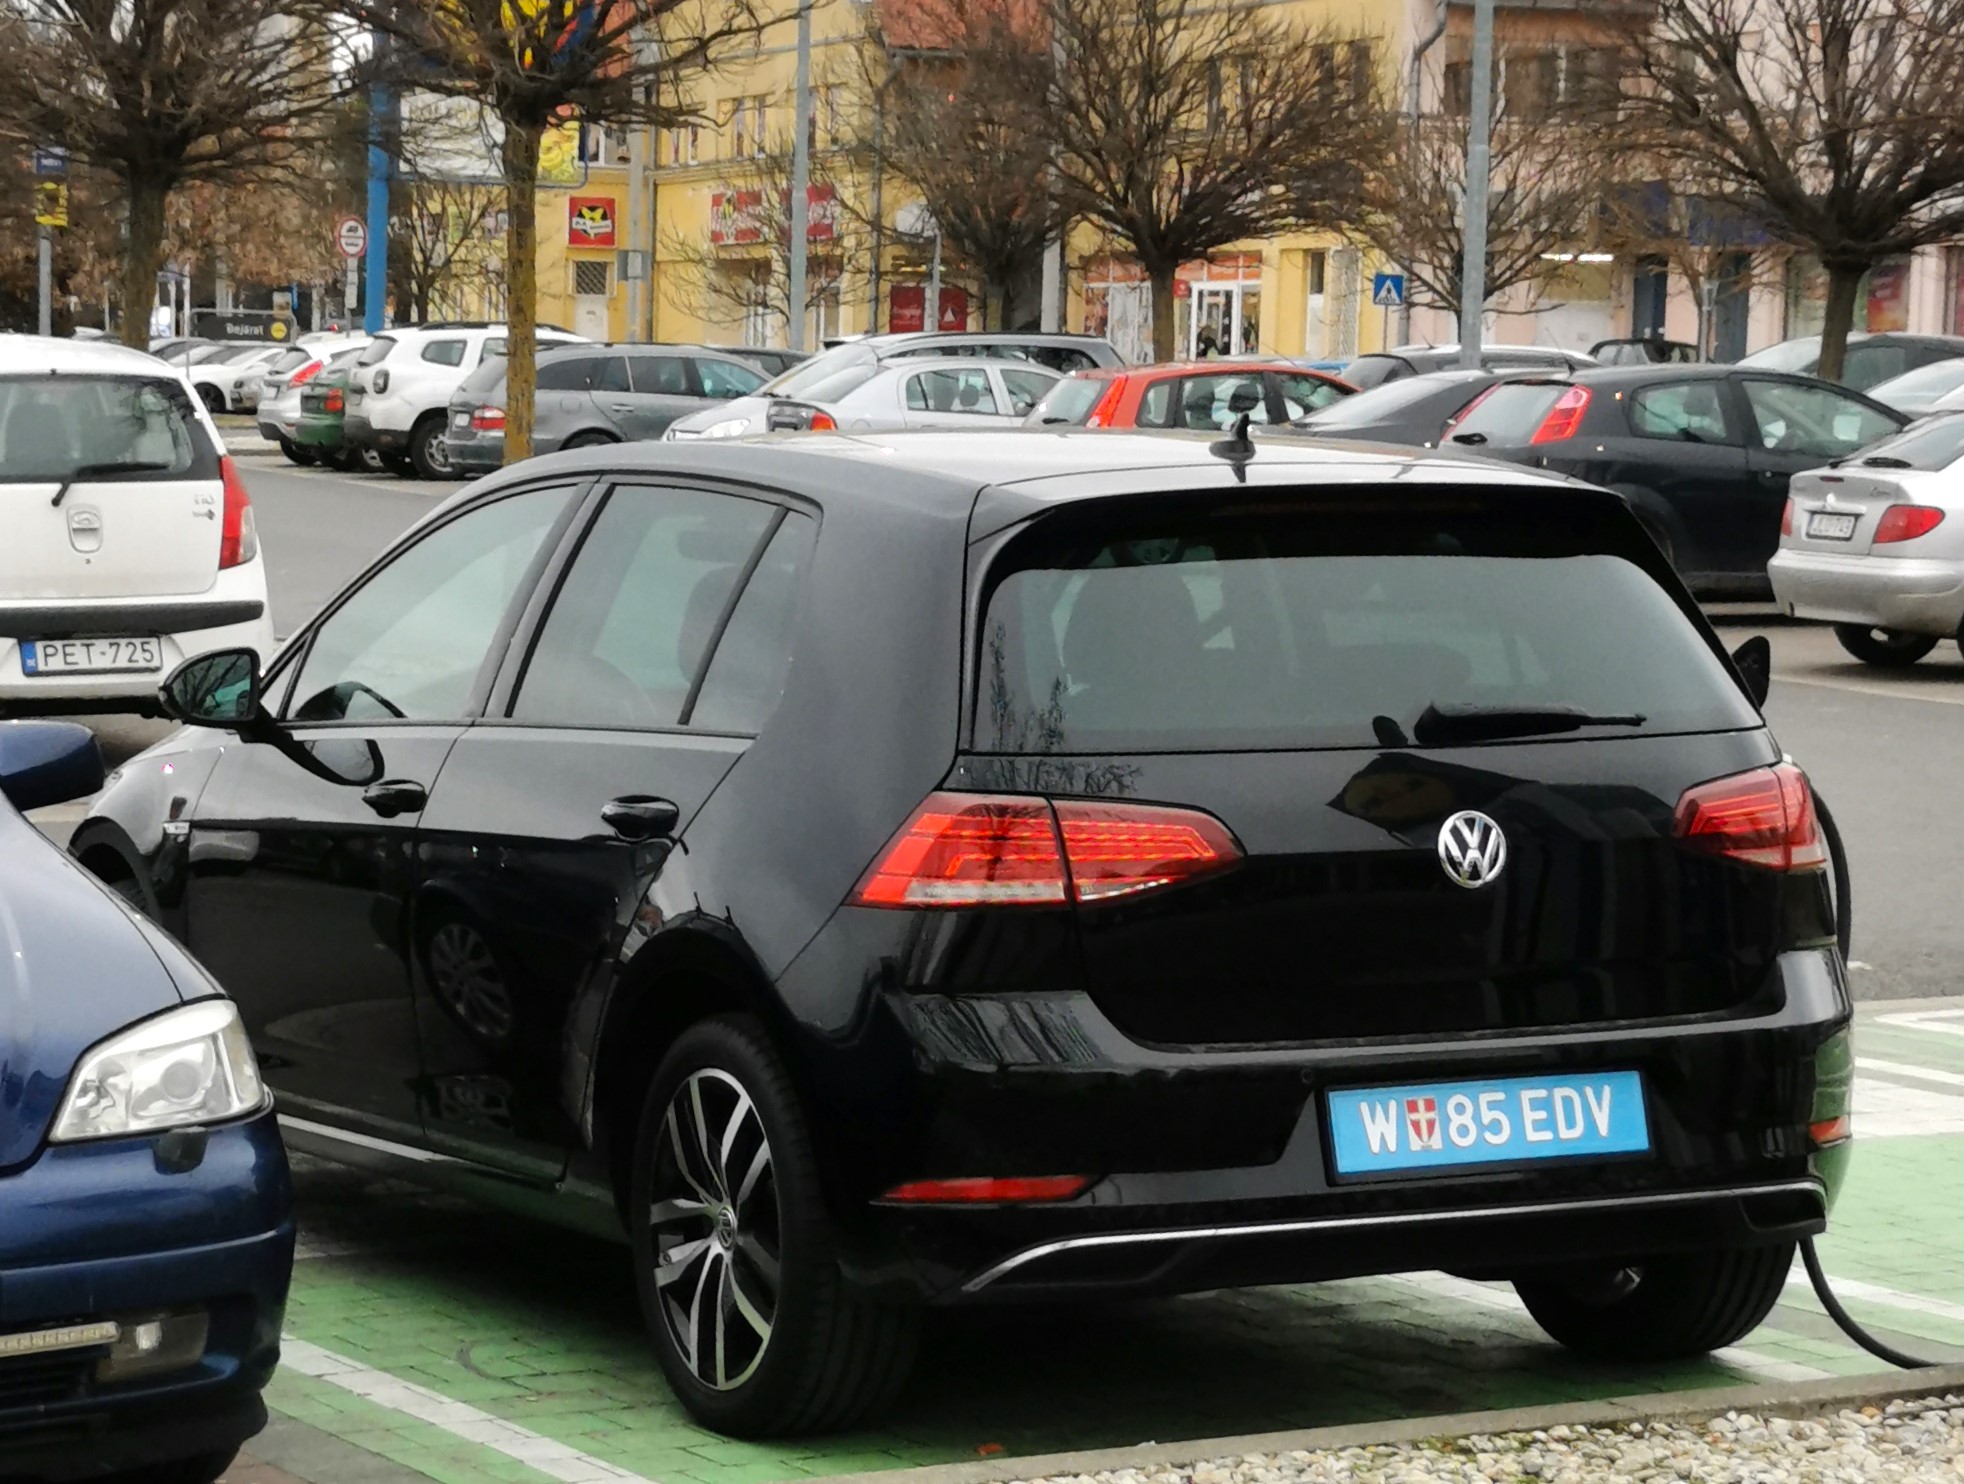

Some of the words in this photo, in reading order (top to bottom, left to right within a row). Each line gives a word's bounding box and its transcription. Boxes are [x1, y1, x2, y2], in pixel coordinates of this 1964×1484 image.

[42, 641, 155, 667] PET-725
[1359, 1098, 1397, 1154] W
[1446, 1091, 1511, 1147] 85
[1519, 1084, 1612, 1142] EDV
